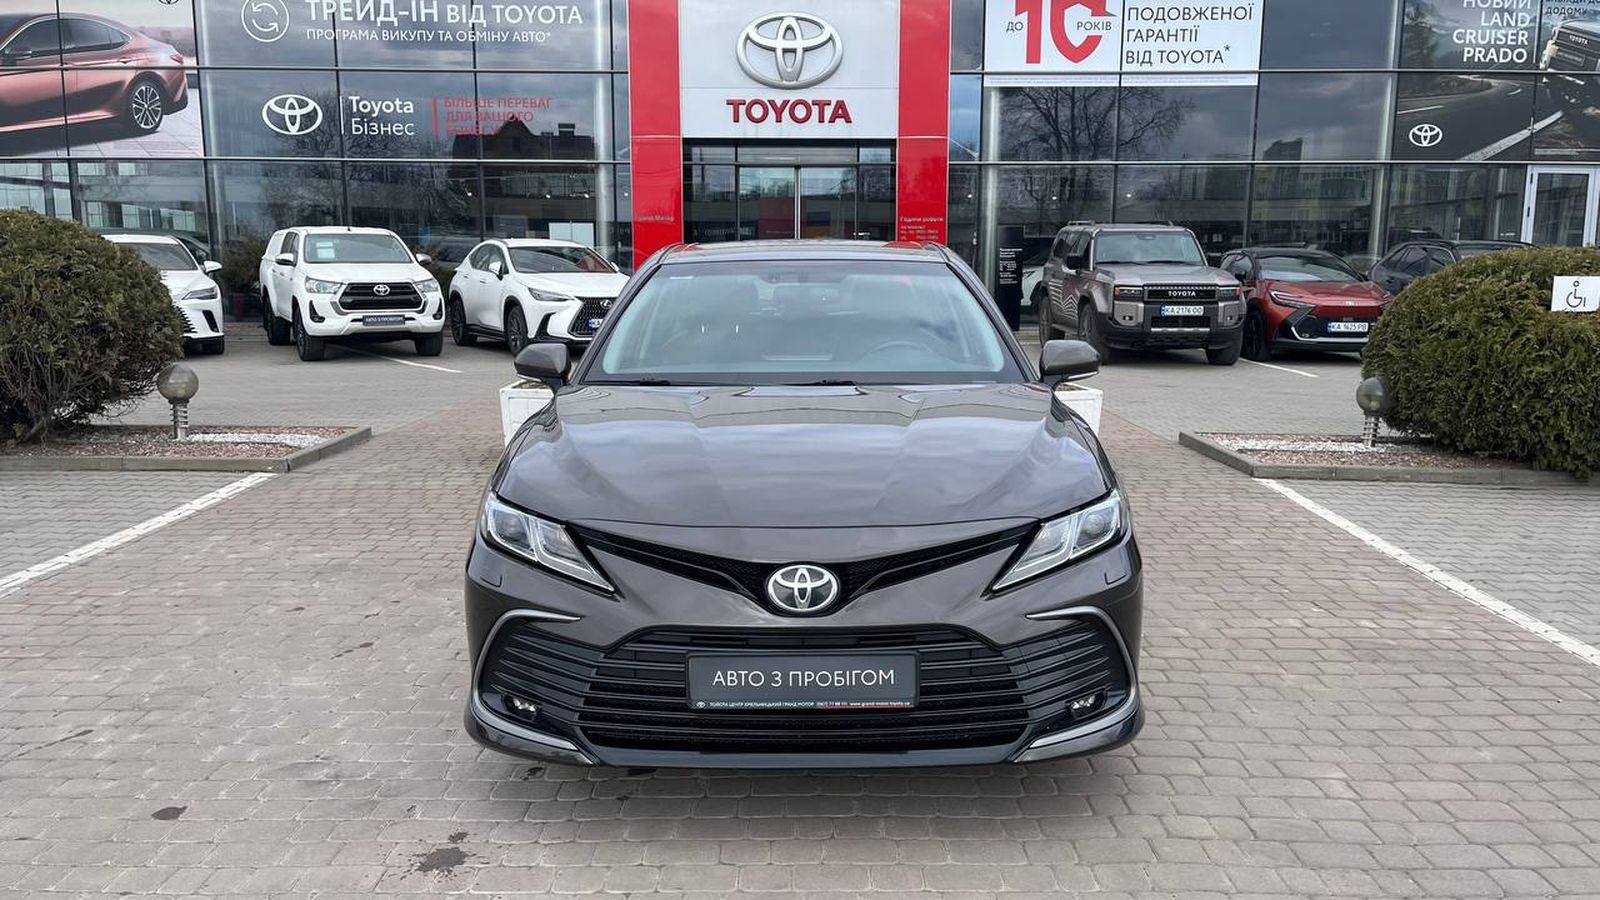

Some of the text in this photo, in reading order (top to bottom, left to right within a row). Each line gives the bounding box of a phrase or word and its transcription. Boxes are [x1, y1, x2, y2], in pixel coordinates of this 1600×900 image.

[447, 5, 487, 27] ВІД
[492, 5, 583, 24] TOYOTA
[1128, 3, 1254, 23] ПОДОВЖЕНОЇ
[1481, 12, 1530, 27] LAND
[1006, 21, 1024, 32] ДО
[1077, 21, 1112, 31] РОКІВ
[1127, 25, 1201, 42] ГАРАНТІЇ
[306, 29, 379, 41] ПРОГРАМА
[382, 30, 435, 41] ВИКУПУ
[438, 30, 454, 41] ТА
[456, 31, 509, 42] ОБМІНУ
[1452, 28, 1529, 45] CRUISER
[1126, 50, 1153, 67] ВІД
[1463, 46, 1528, 63] PRADO
[348, 95, 415, 117] Toyota
[726, 98, 853, 124] TOYOTA
[351, 117, 415, 136] Бізнес
[712, 670, 895, 687] АВТО З ПРОБІГОМ
